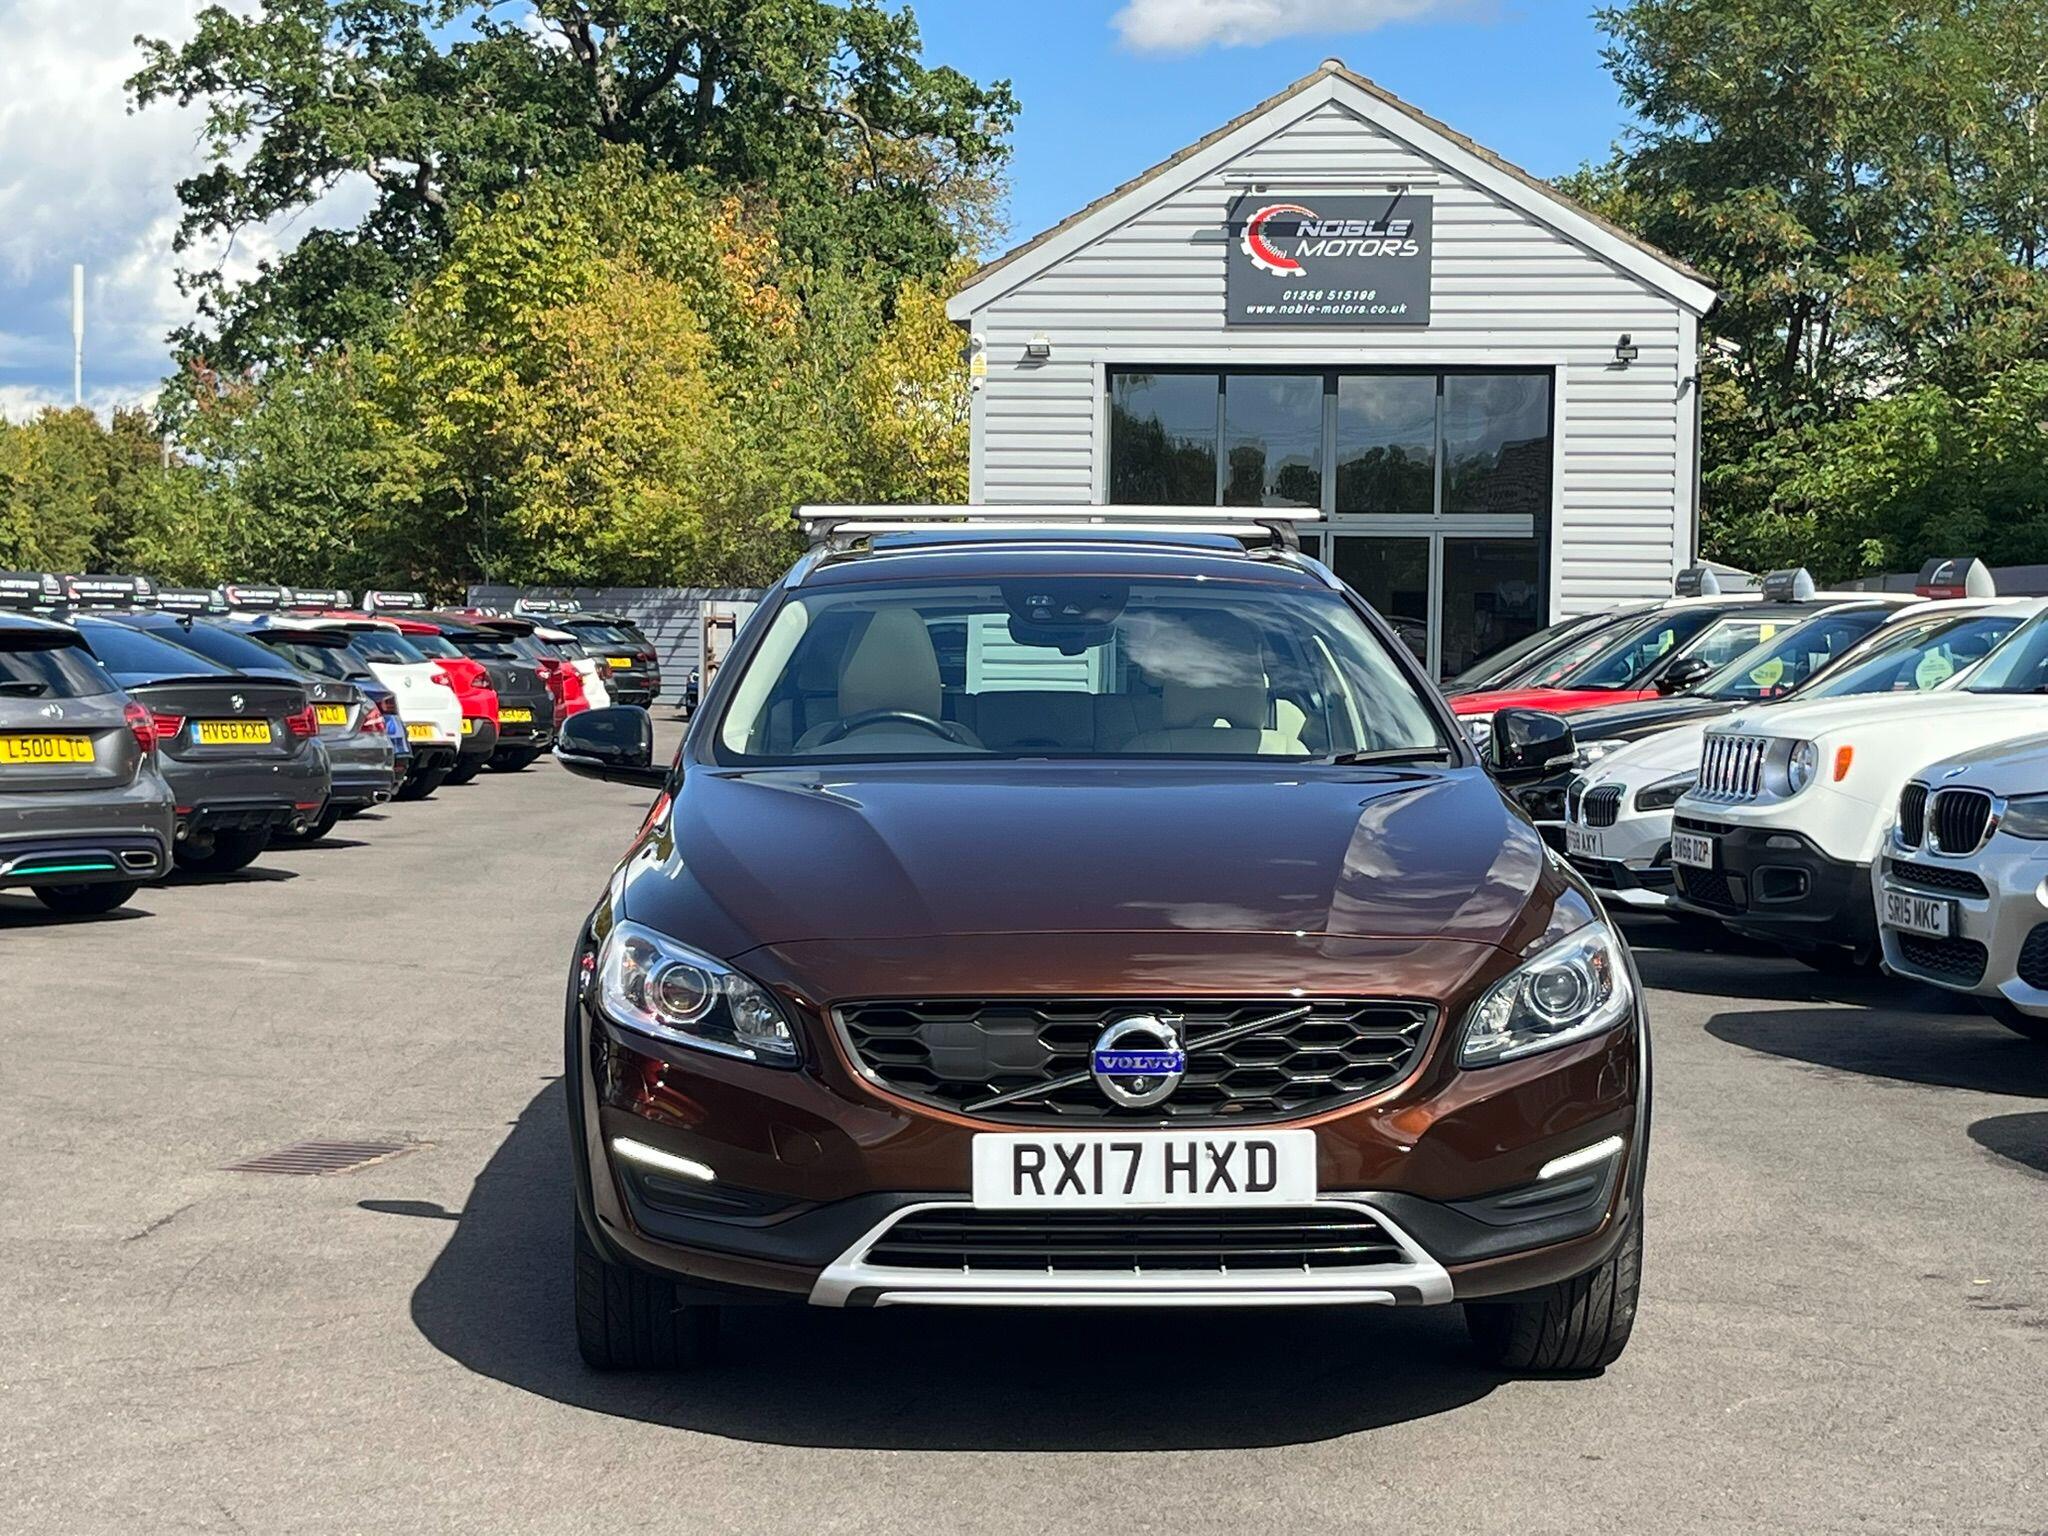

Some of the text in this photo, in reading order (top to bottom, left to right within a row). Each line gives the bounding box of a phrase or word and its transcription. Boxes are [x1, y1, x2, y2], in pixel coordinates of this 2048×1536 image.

[1296, 219, 1411, 237] NOBLE
[1295, 239, 1419, 257] MOTORS
[1246, 303, 1407, 314] www.noble-motors.co.uk
[201, 723, 238, 740] HV68
[8, 738, 86, 758] L500 LTC
[1888, 894, 1939, 929] SR15 MKC
[1099, 1056, 1177, 1069] VOLVO
[1013, 1141, 1277, 1195] RX17 HXD
